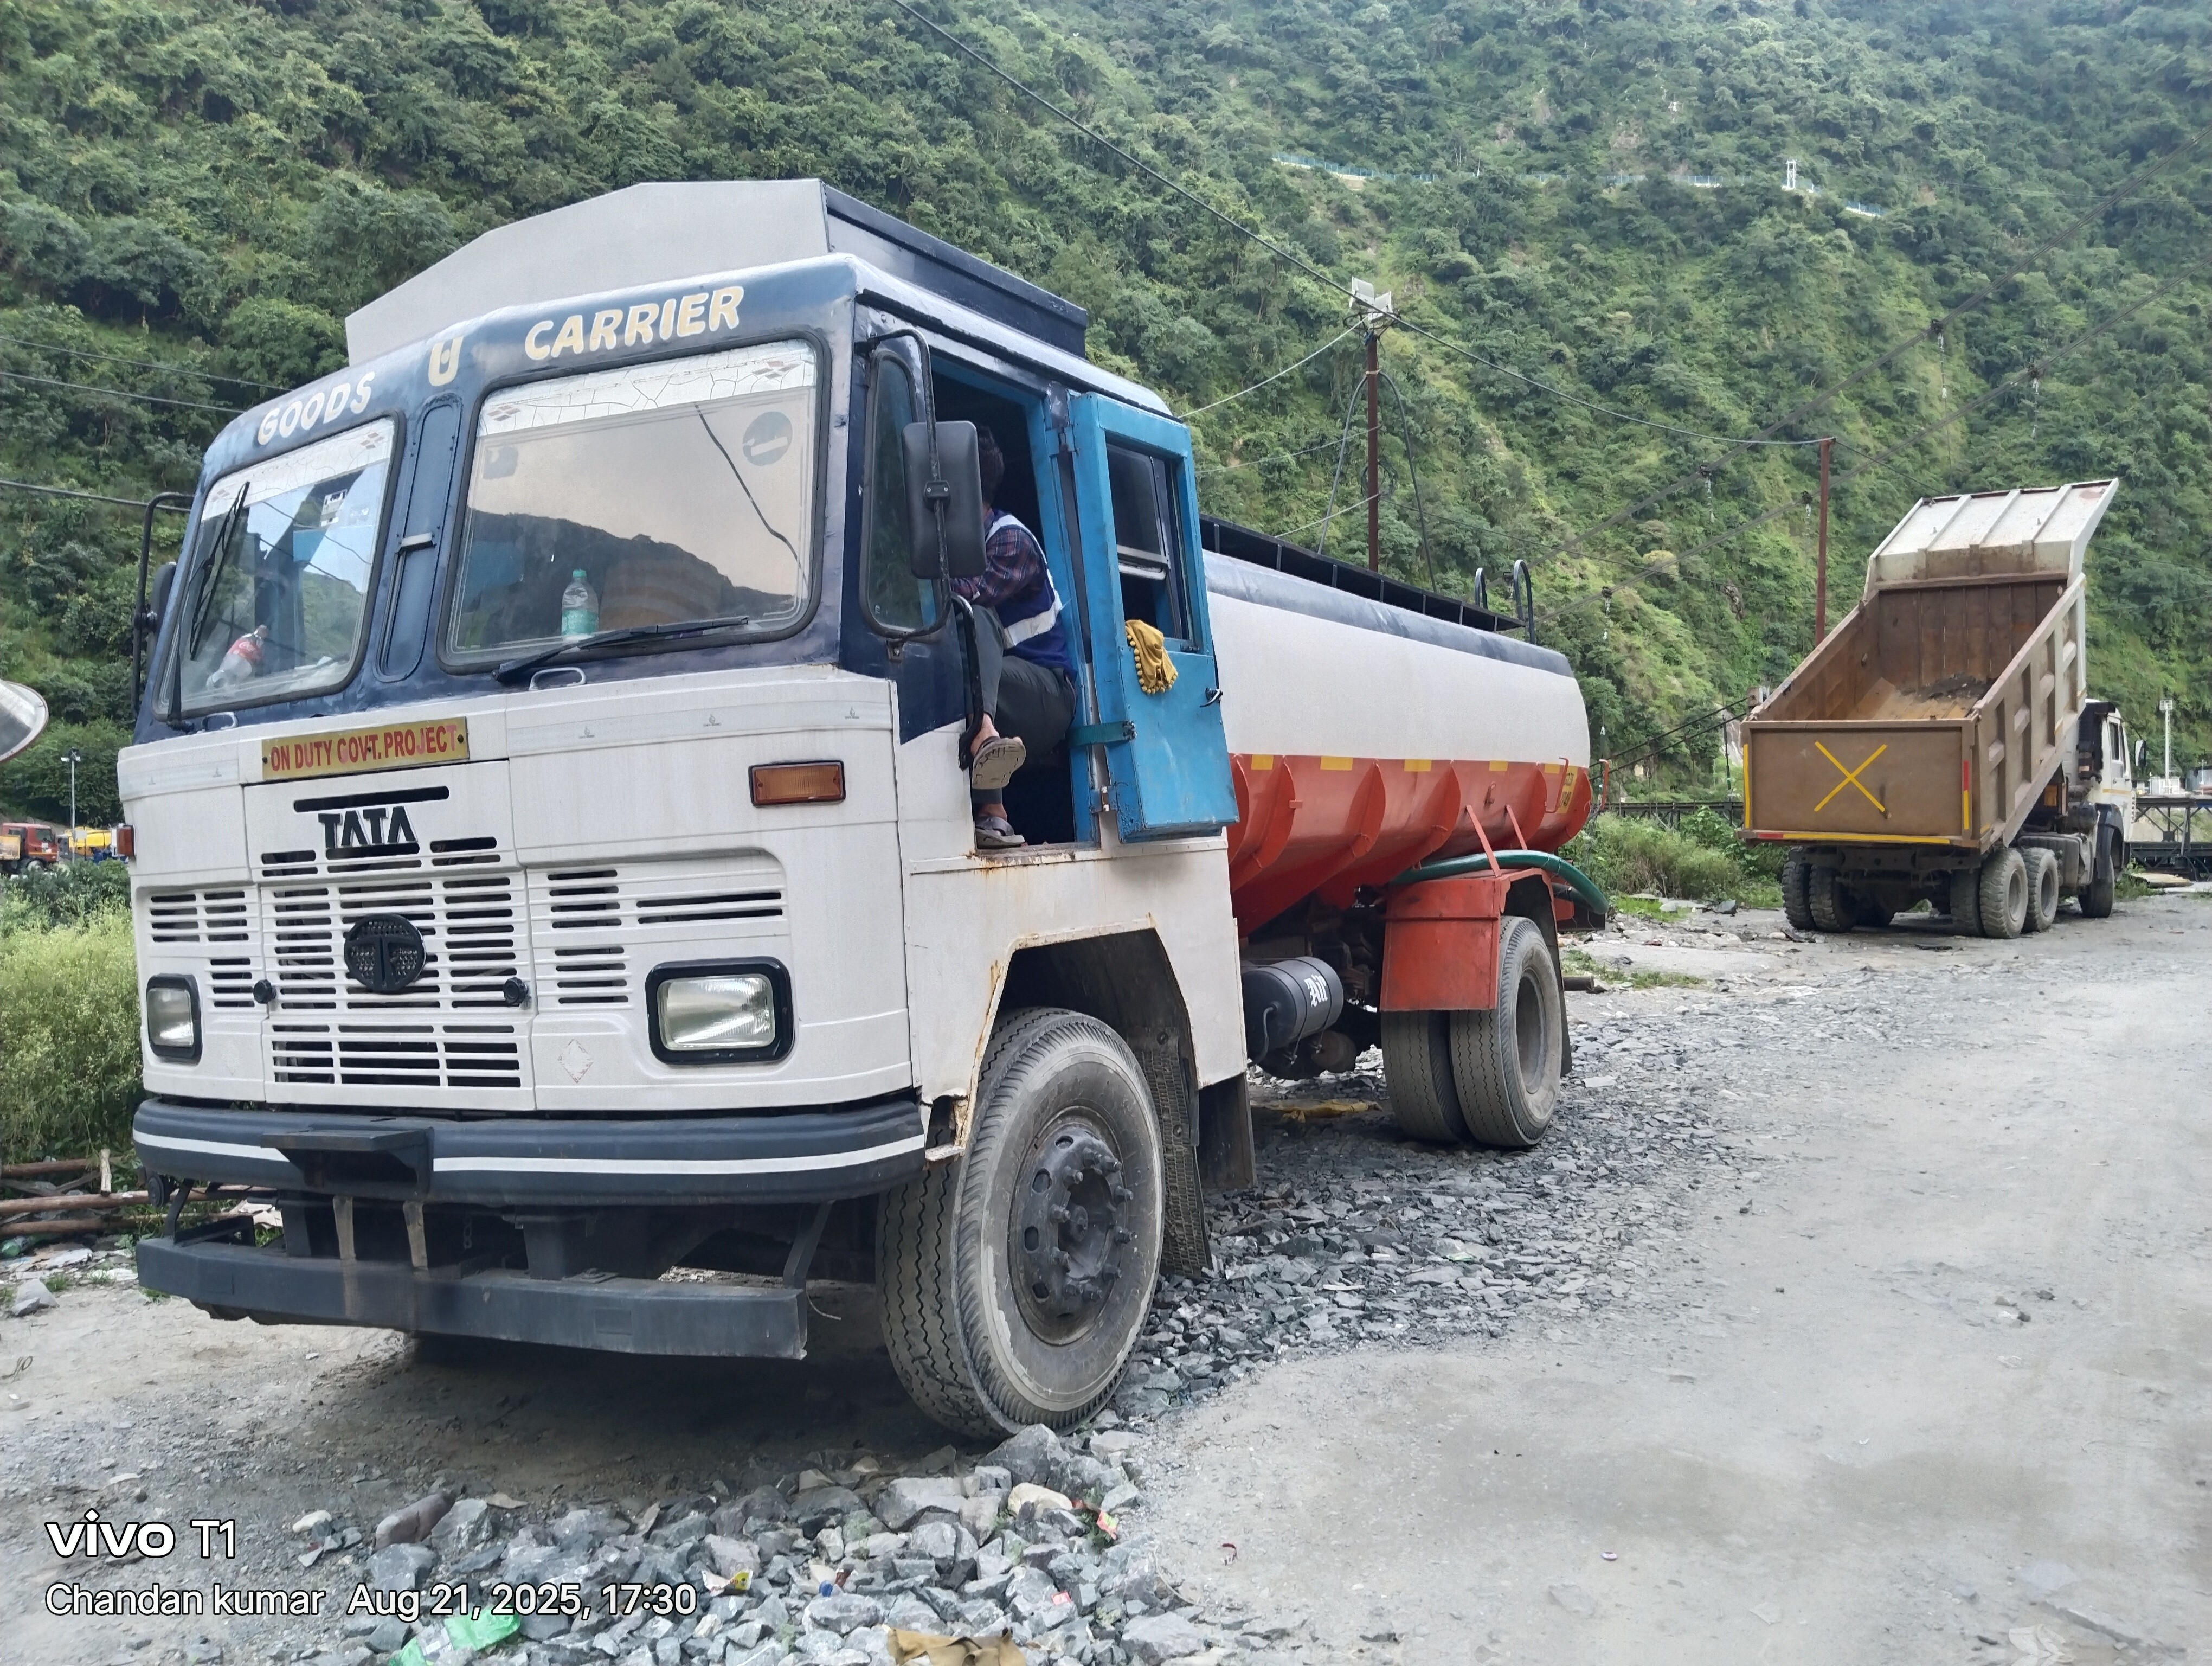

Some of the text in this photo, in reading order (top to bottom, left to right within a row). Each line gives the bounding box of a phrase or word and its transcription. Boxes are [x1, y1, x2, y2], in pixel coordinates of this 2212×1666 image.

[258, 371, 374, 446] GOODS
[524, 286, 744, 361] CARRIER
[271, 745, 290, 771] ON
[295, 739, 332, 769] DUTY
[384, 724, 457, 759] PROJECT
[318, 806, 418, 849] TATA
